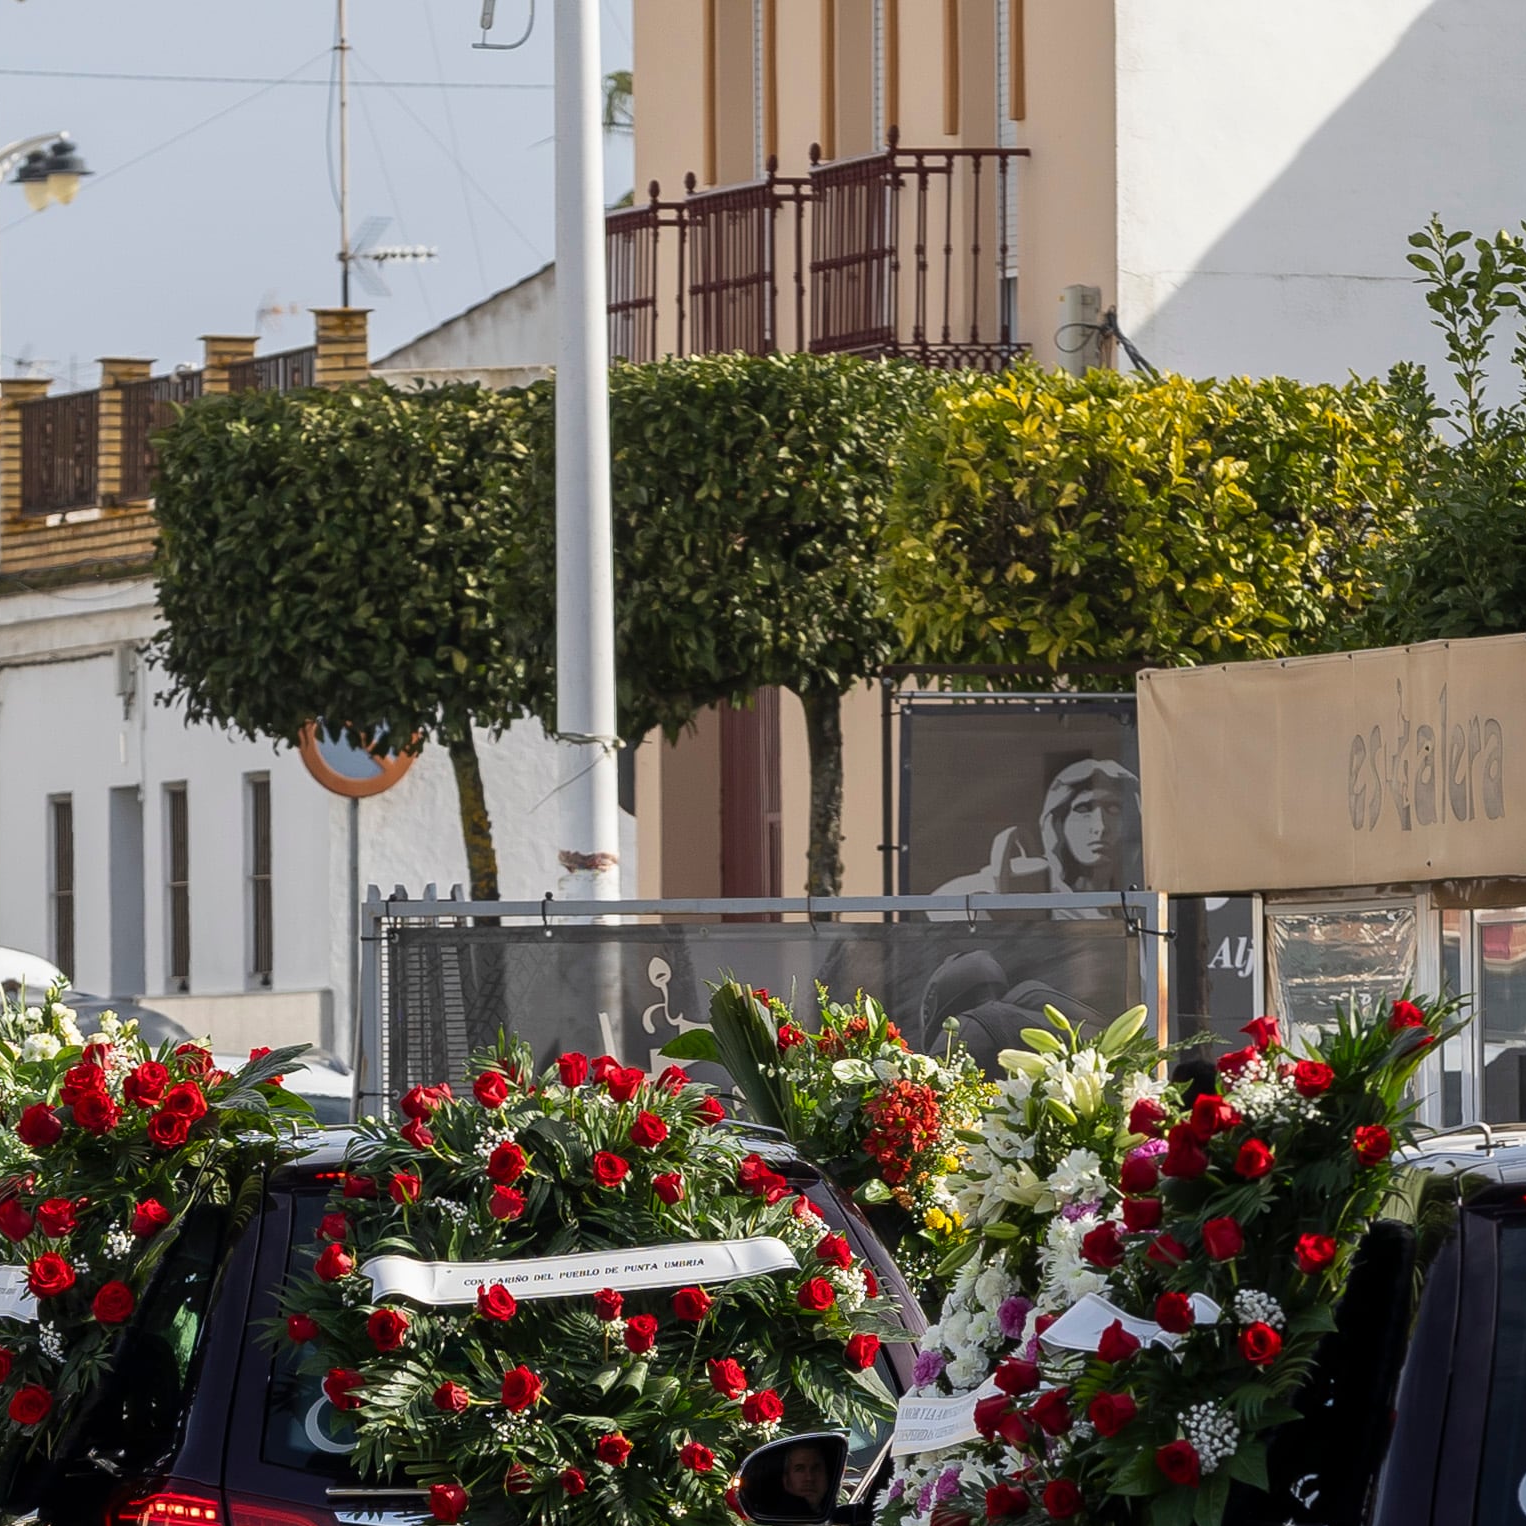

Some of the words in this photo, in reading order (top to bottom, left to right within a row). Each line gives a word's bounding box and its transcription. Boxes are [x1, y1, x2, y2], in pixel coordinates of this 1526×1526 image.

[1208, 936, 1254, 978] Alj
[463, 1278, 486, 1287] CON
[489, 1273, 529, 1286] CARIÑO
[533, 1273, 554, 1282] DEL
[559, 1268, 600, 1280] PUEBLO
[604, 1266, 619, 1275] DE
[624, 1262, 659, 1273] PUNTA
